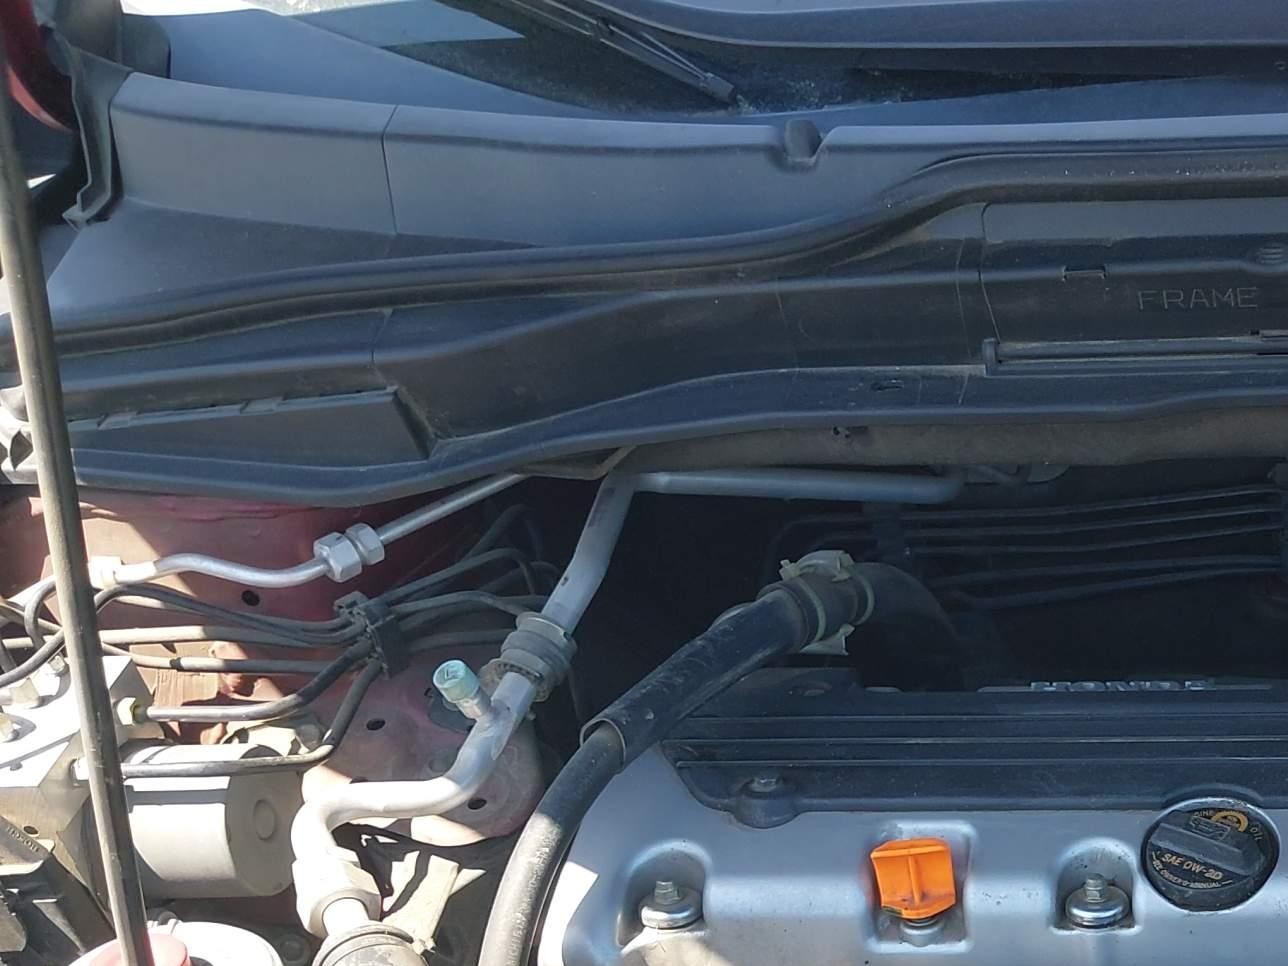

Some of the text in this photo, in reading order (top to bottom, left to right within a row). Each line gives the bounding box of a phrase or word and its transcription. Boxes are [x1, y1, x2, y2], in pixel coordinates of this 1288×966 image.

[1137, 287, 1261, 311] FRAME
[1161, 853, 1224, 880] SAE 0W-20
